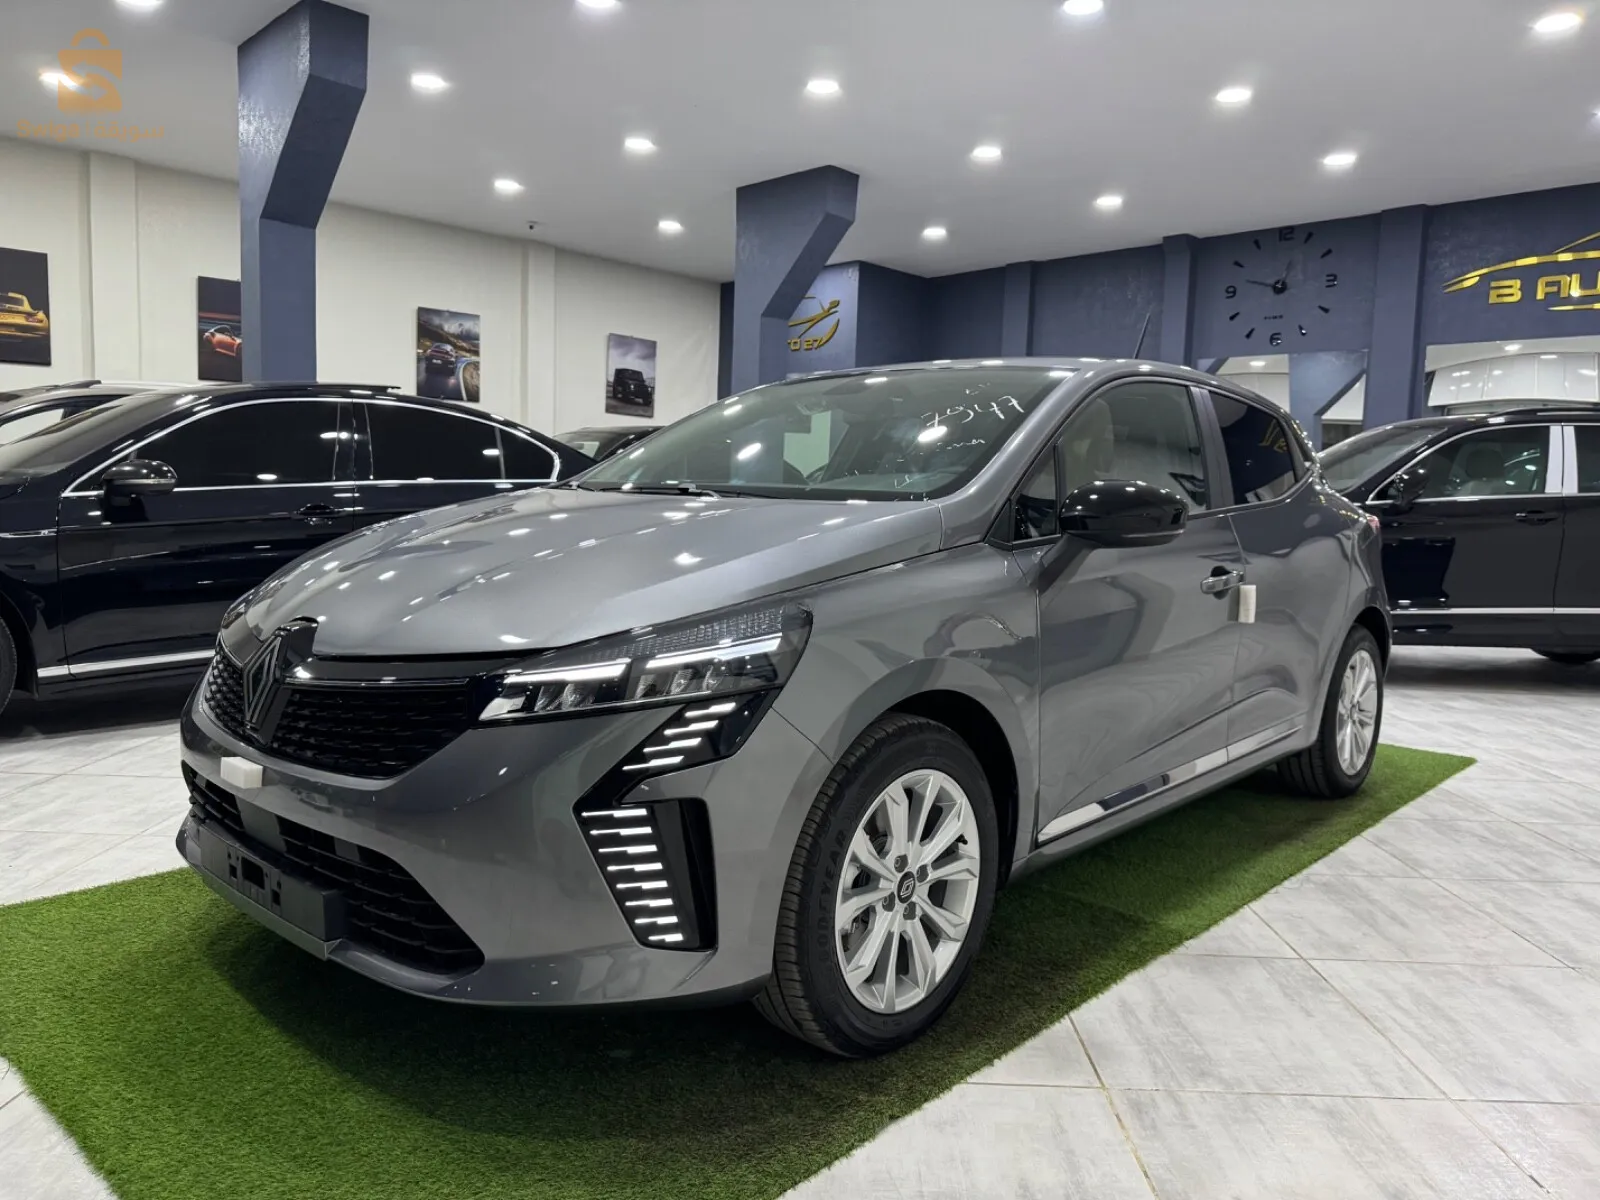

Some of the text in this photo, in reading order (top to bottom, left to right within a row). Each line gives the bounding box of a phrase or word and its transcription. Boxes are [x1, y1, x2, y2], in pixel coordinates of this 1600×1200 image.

[1278, 226, 1295, 242] 12
[1325, 273, 1338, 288] 3
[1488, 272, 1600, 304] B AU
[1225, 285, 1237, 299] 9
[787, 338, 801, 351] O
[1269, 332, 1282, 347] 6
[815, 829, 847, 975] OODYEAR
